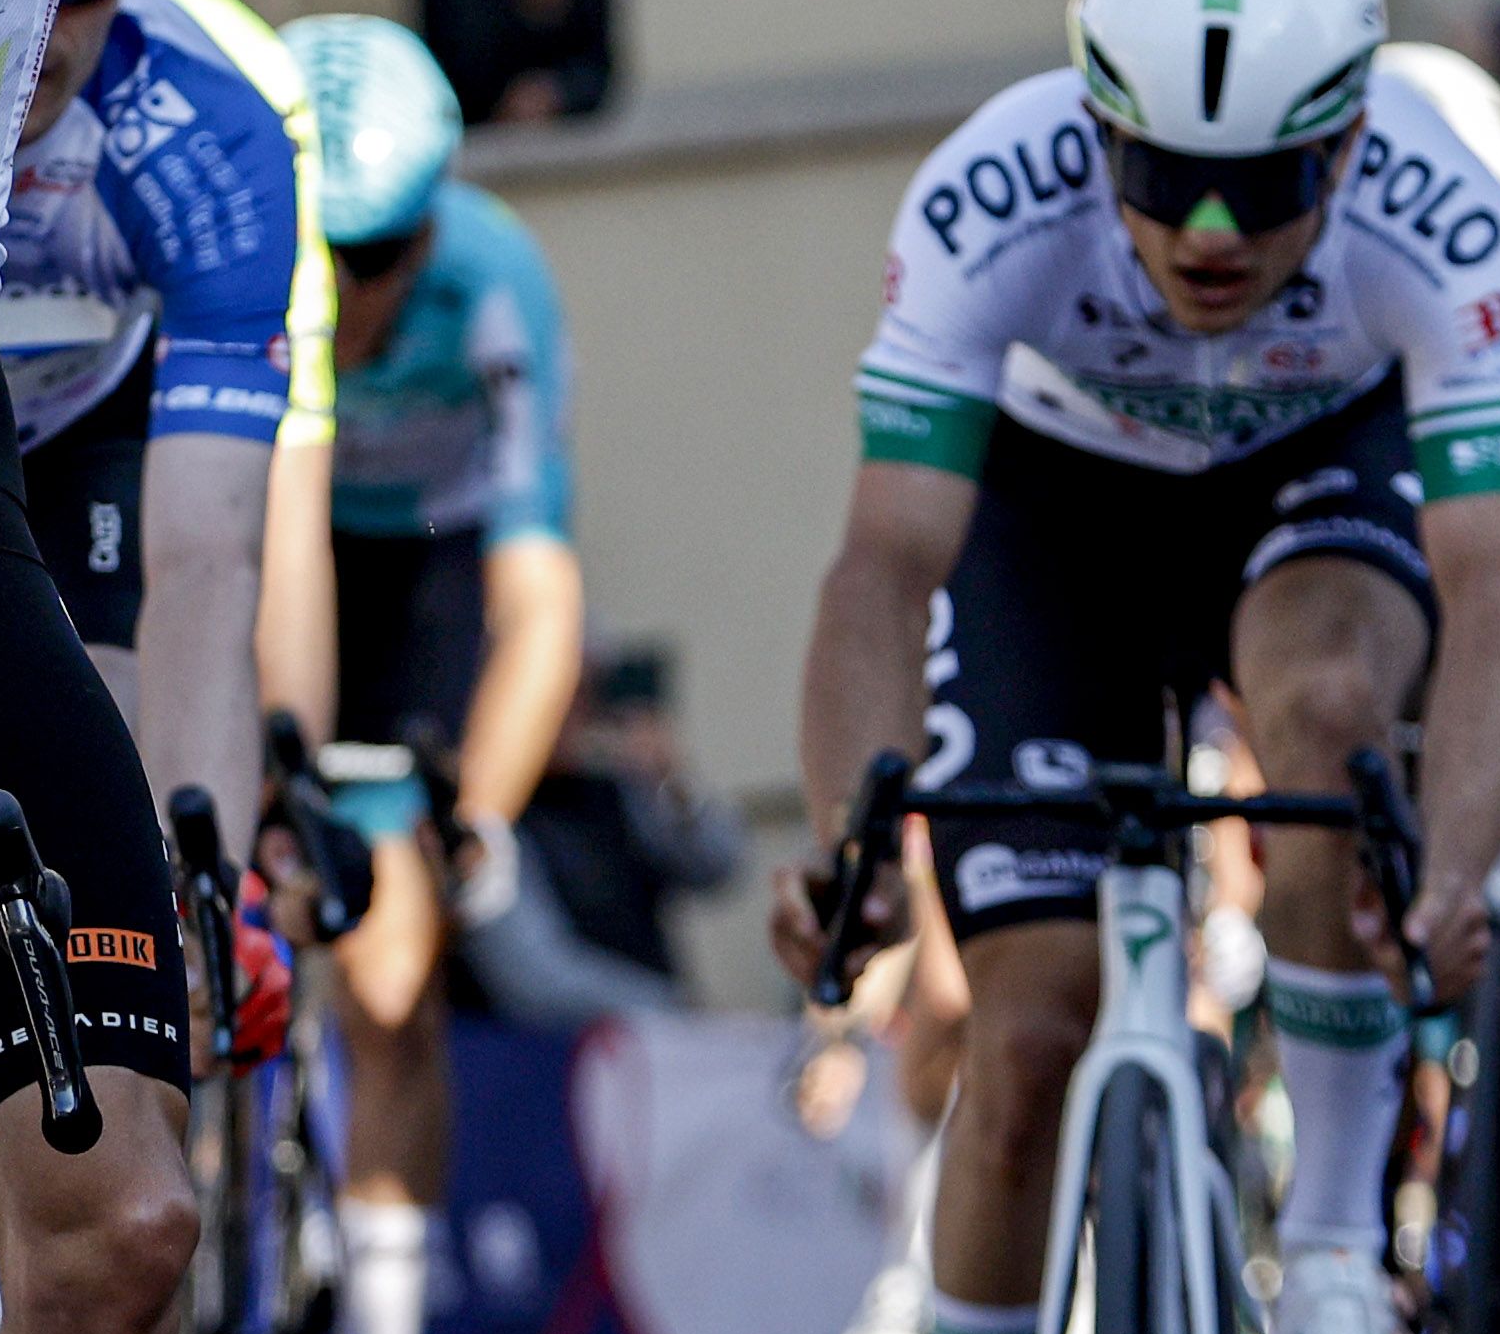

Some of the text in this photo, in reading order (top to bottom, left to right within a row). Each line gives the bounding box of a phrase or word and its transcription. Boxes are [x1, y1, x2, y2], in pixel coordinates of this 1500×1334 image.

[923, 122, 1092, 255] POLO
[1359, 132, 1500, 266] POLO
[69, 932, 150, 964] OBIK
